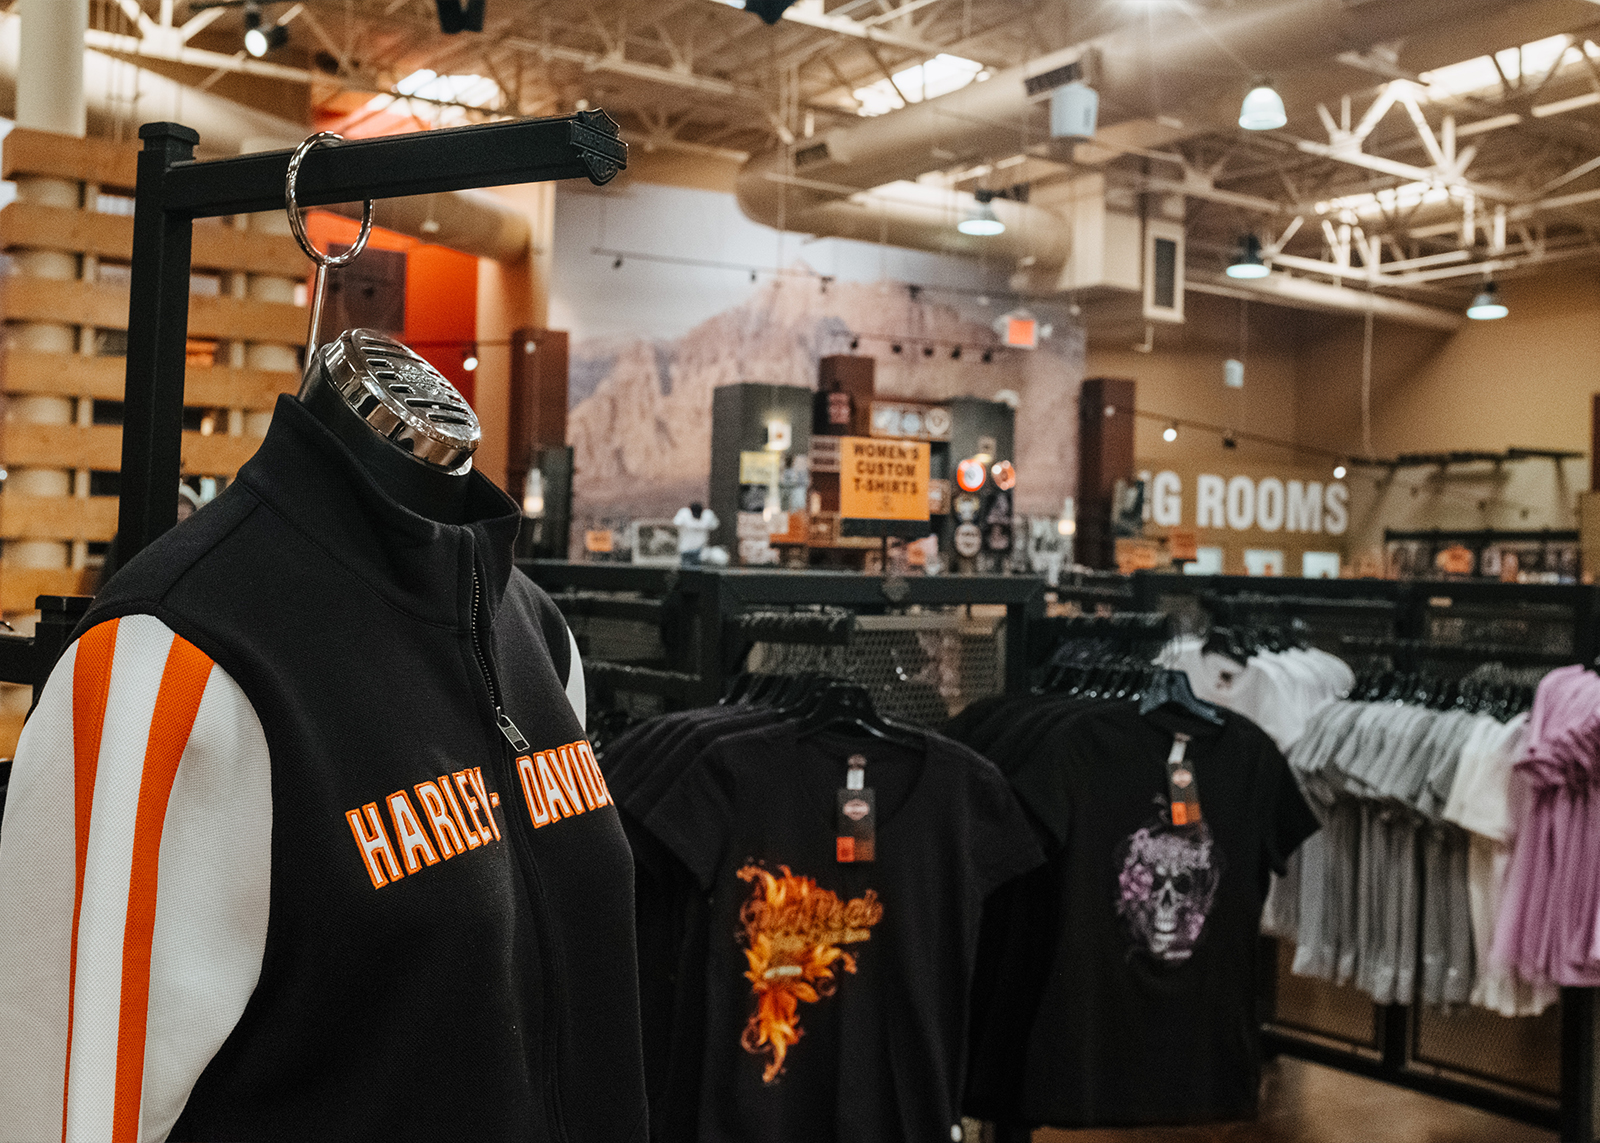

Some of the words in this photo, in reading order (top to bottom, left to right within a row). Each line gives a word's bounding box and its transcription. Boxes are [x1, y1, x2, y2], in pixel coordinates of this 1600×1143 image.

[853, 443, 920, 460] WOMEN'S
[856, 460, 916, 477] CUSTOM
[853, 477, 920, 495] T-SHIRTS
[1196, 474, 1350, 536] ROOMS
